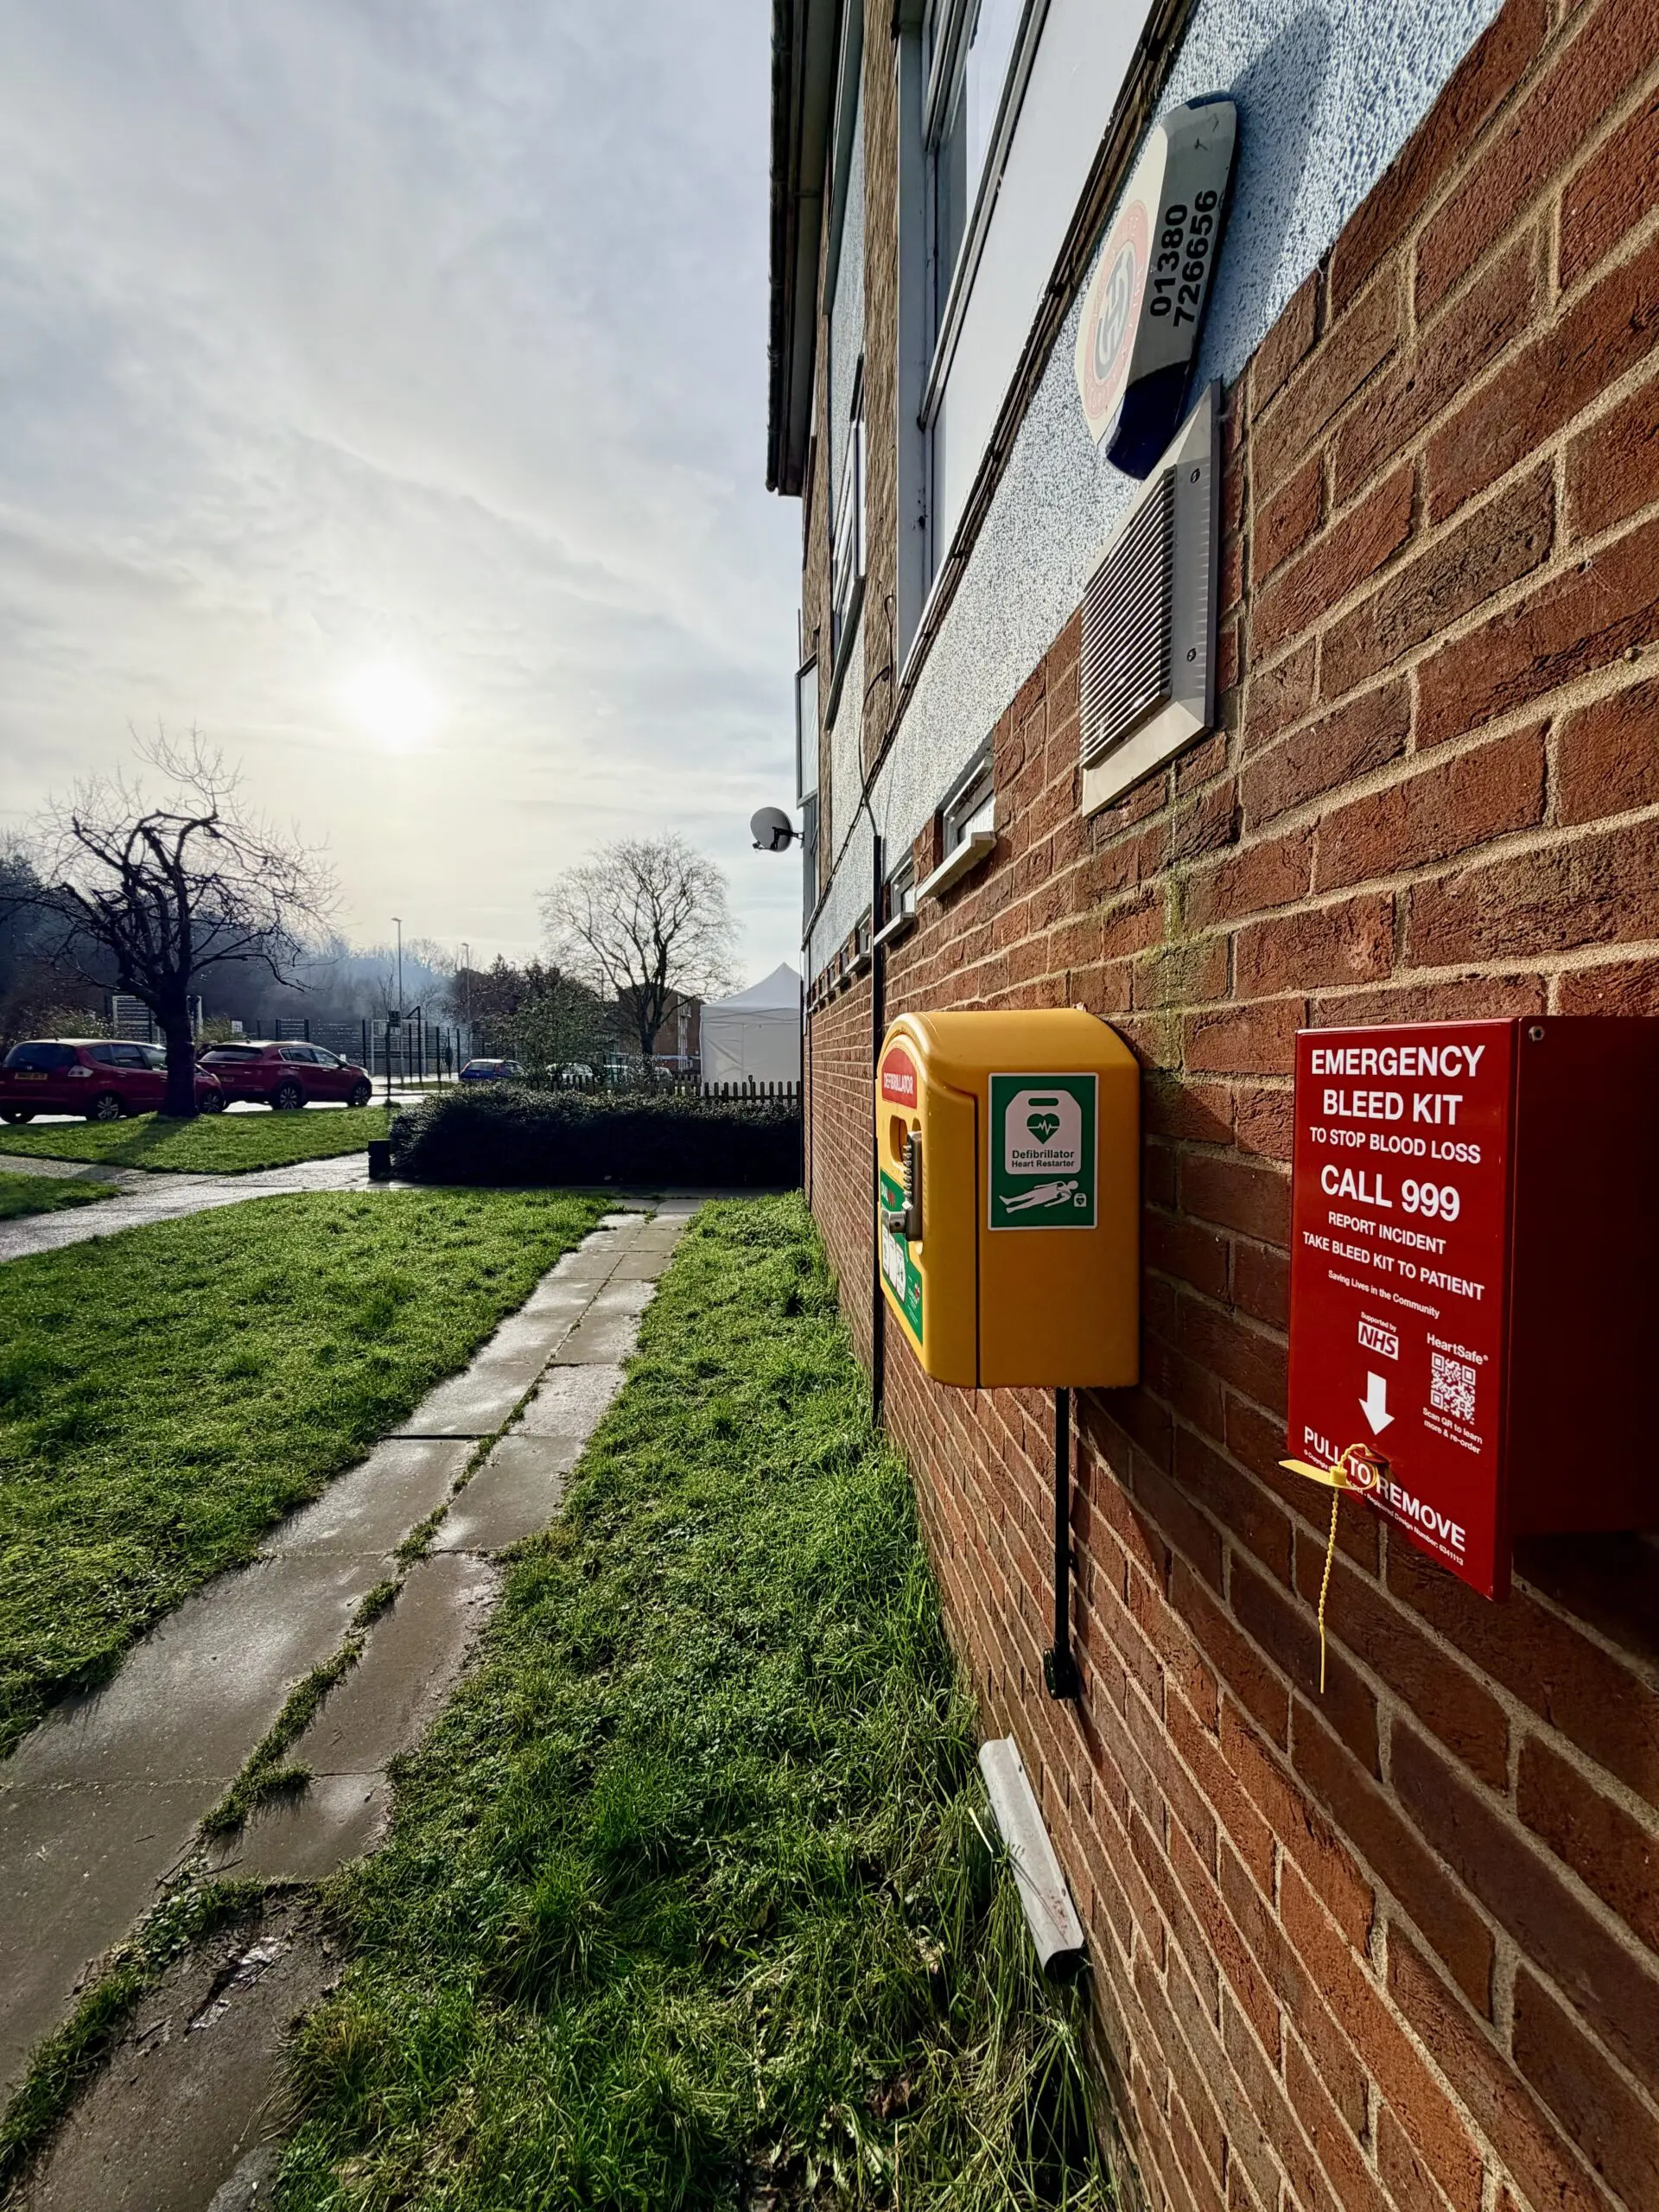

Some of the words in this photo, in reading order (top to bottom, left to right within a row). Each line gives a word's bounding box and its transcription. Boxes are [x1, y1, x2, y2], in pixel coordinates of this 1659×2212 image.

[1150, 204, 1188, 317] 01380
[1173, 190, 1218, 327] 726656
[1311, 1045, 1486, 1077] EMERGENCY
[883, 1071, 914, 1096] DEFIBRILLATOR
[1323, 1089, 1404, 1121] BLEED
[1413, 1092, 1464, 1126] KIT
[1012, 1149, 1075, 1160] Defibrillator
[1012, 1160, 1034, 1168] Heart
[1309, 1126, 1327, 1144] TO
[1329, 1128, 1366, 1148] STOP
[1370, 1133, 1427, 1157] BLOOD
[1431, 1140, 1482, 1165] LOSS
[1320, 1164, 1393, 1208] CALL
[1401, 1179, 1460, 1222] 999
[1328, 1211, 1376, 1236] REPORT
[1378, 1224, 1446, 1255] INCIDENT
[1302, 1230, 1330, 1251] TAKE
[1332, 1240, 1370, 1264] BLEED
[1373, 1252, 1395, 1272] KIT
[1397, 1260, 1417, 1279] TO
[1420, 1267, 1485, 1300] PATIENT
[1328, 1269, 1350, 1287] Saving
[1351, 1278, 1370, 1293] Lives
[1370, 1285, 1378, 1295] in
[1378, 1288, 1392, 1300] the
[1392, 1293, 1440, 1319] Community
[1359, 1323, 1397, 1357] NHS
[1361, 1311, 1389, 1328] Supported
[1389, 1322, 1397, 1332] by
[1422, 1407, 1440, 1422] Scan
[1440, 1416, 1452, 1429] QR
[1453, 1423, 1462, 1433] to
[1463, 1427, 1484, 1445] learn
[1423, 1420, 1442, 1434] more
[1450, 1433, 1482, 1454] re-order
[1304, 1425, 1340, 1466] PULL
[1347, 1454, 1371, 1486] TO
[1376, 1472, 1466, 1553] REMOVE
[1394, 1512, 1414, 1531] Design
[1414, 1525, 1439, 1548] Number:
